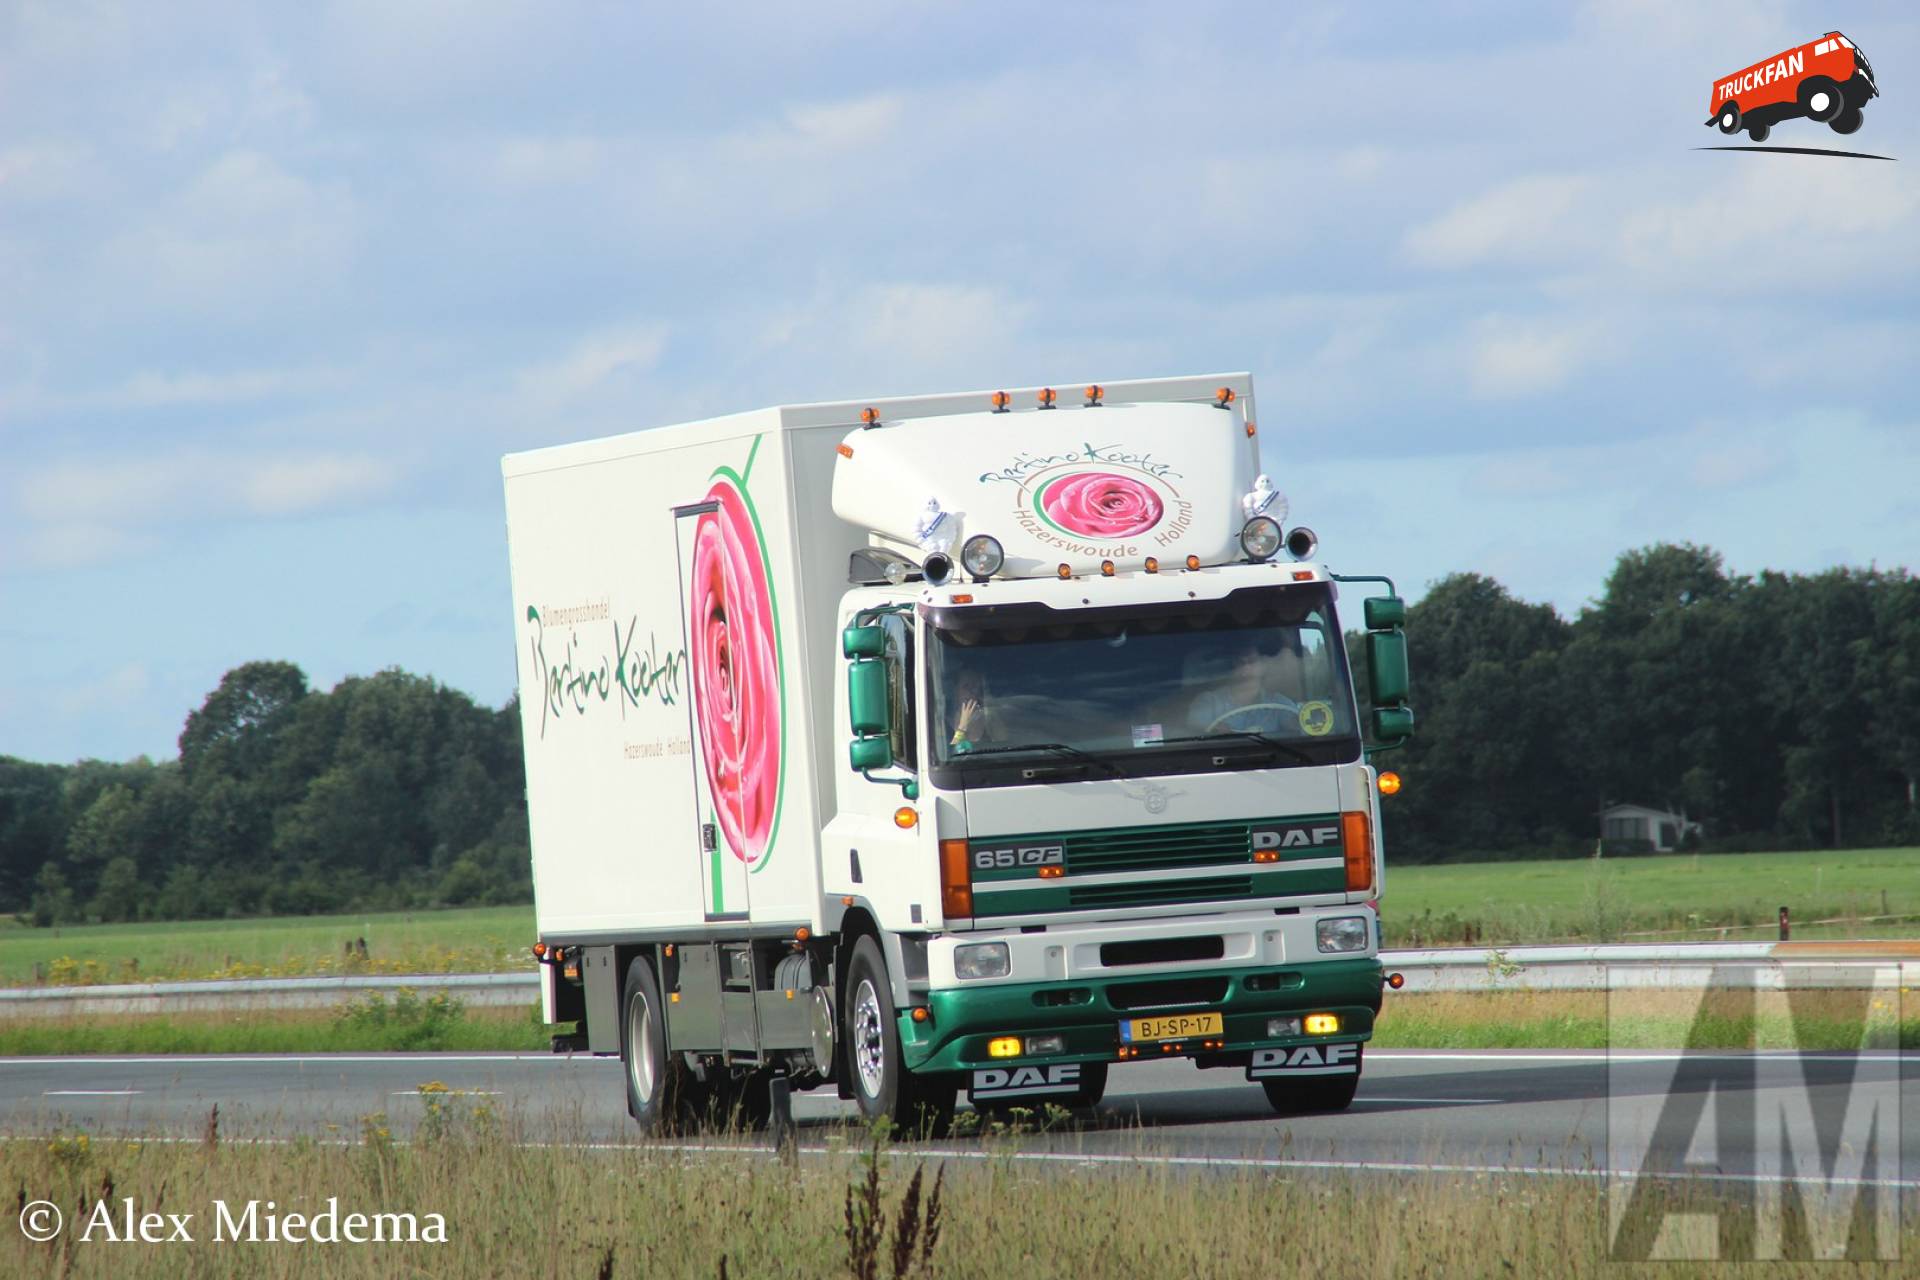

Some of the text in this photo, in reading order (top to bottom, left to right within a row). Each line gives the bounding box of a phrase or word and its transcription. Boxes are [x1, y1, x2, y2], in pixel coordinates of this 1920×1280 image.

[1012, 500, 1192, 558] Hazerswoude Holland
[1253, 827, 1339, 848] DAF
[1141, 1016, 1212, 1037] BJ-SP-17
[1252, 1043, 1357, 1067] DAF
[974, 1063, 1080, 1088] DAF
